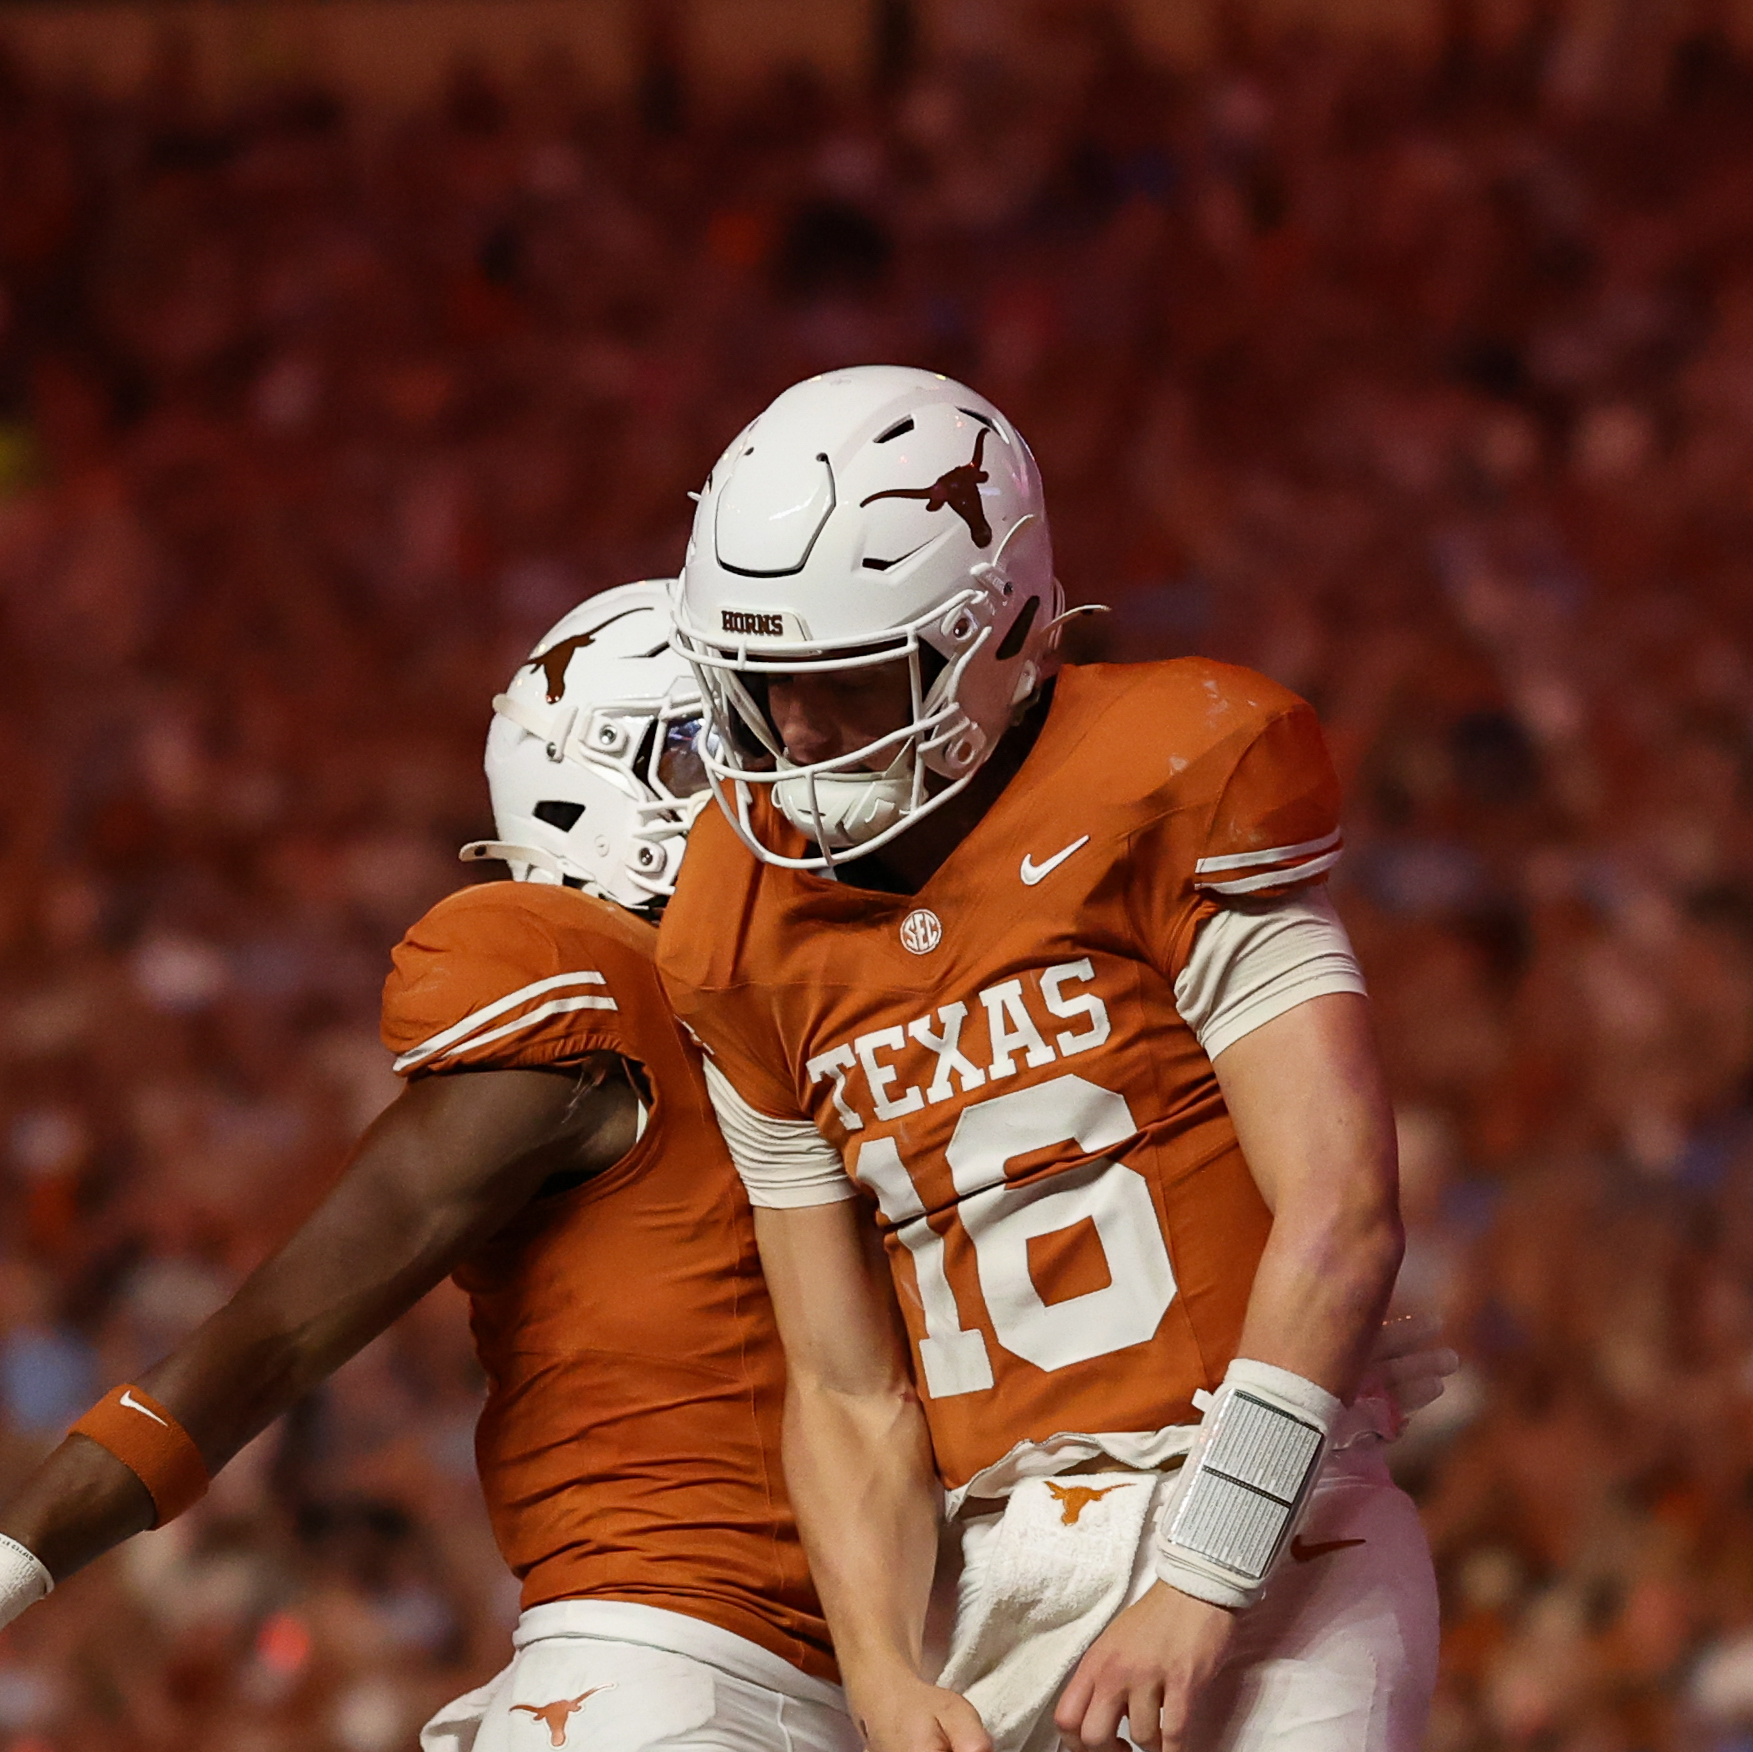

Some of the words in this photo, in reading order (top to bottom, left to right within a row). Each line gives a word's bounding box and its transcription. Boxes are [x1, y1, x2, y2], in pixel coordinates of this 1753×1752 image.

[721, 610, 784, 637] HORNS
[904, 912, 939, 952] SEC
[806, 957, 1113, 1131] TEXAS
[855, 1073, 1178, 1400] 16
